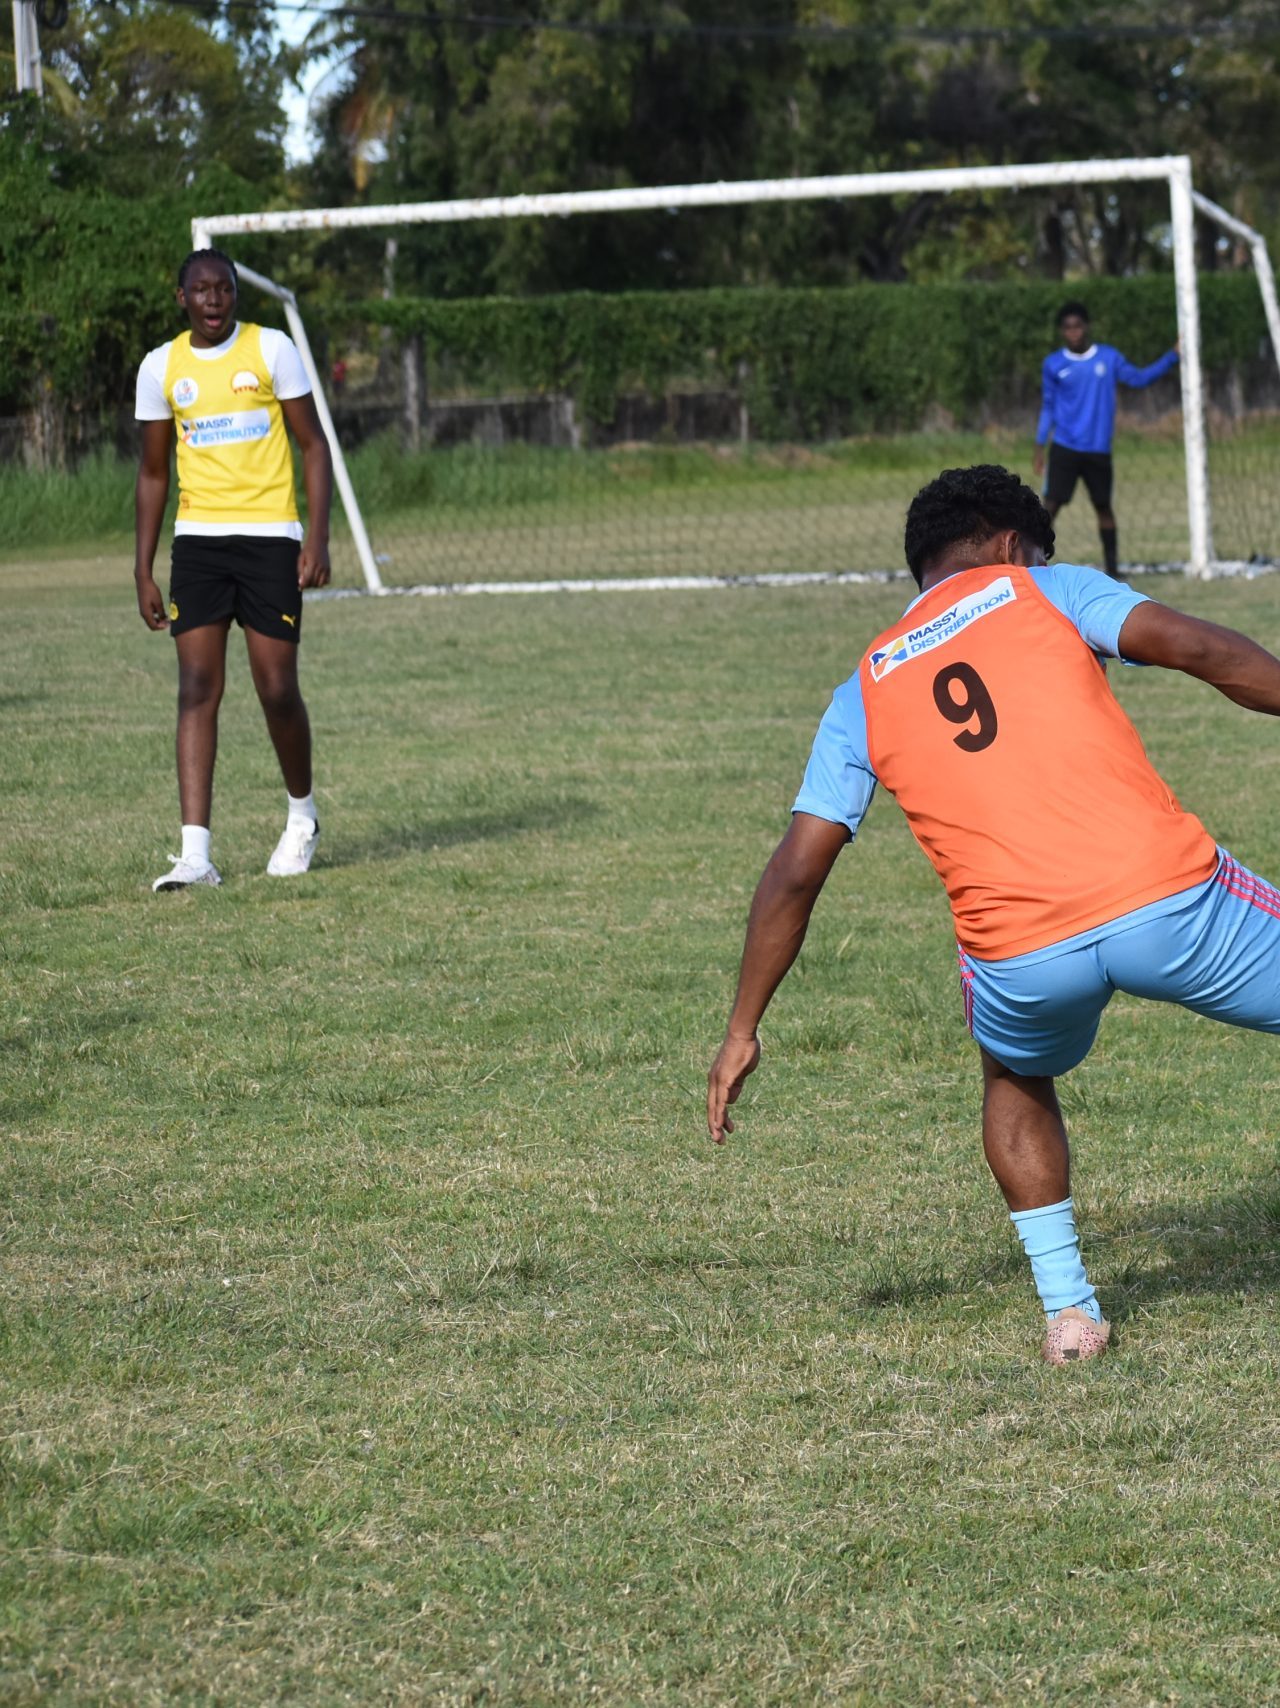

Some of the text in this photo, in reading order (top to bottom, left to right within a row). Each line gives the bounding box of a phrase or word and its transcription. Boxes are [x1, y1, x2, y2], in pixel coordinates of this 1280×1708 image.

[196, 416, 234, 430] MASSY
[200, 423, 269, 442] DISTRIBUTION
[908, 607, 959, 643] MASSY
[911, 589, 1011, 654] DISTRIBUTION
[932, 661, 998, 753] 9
